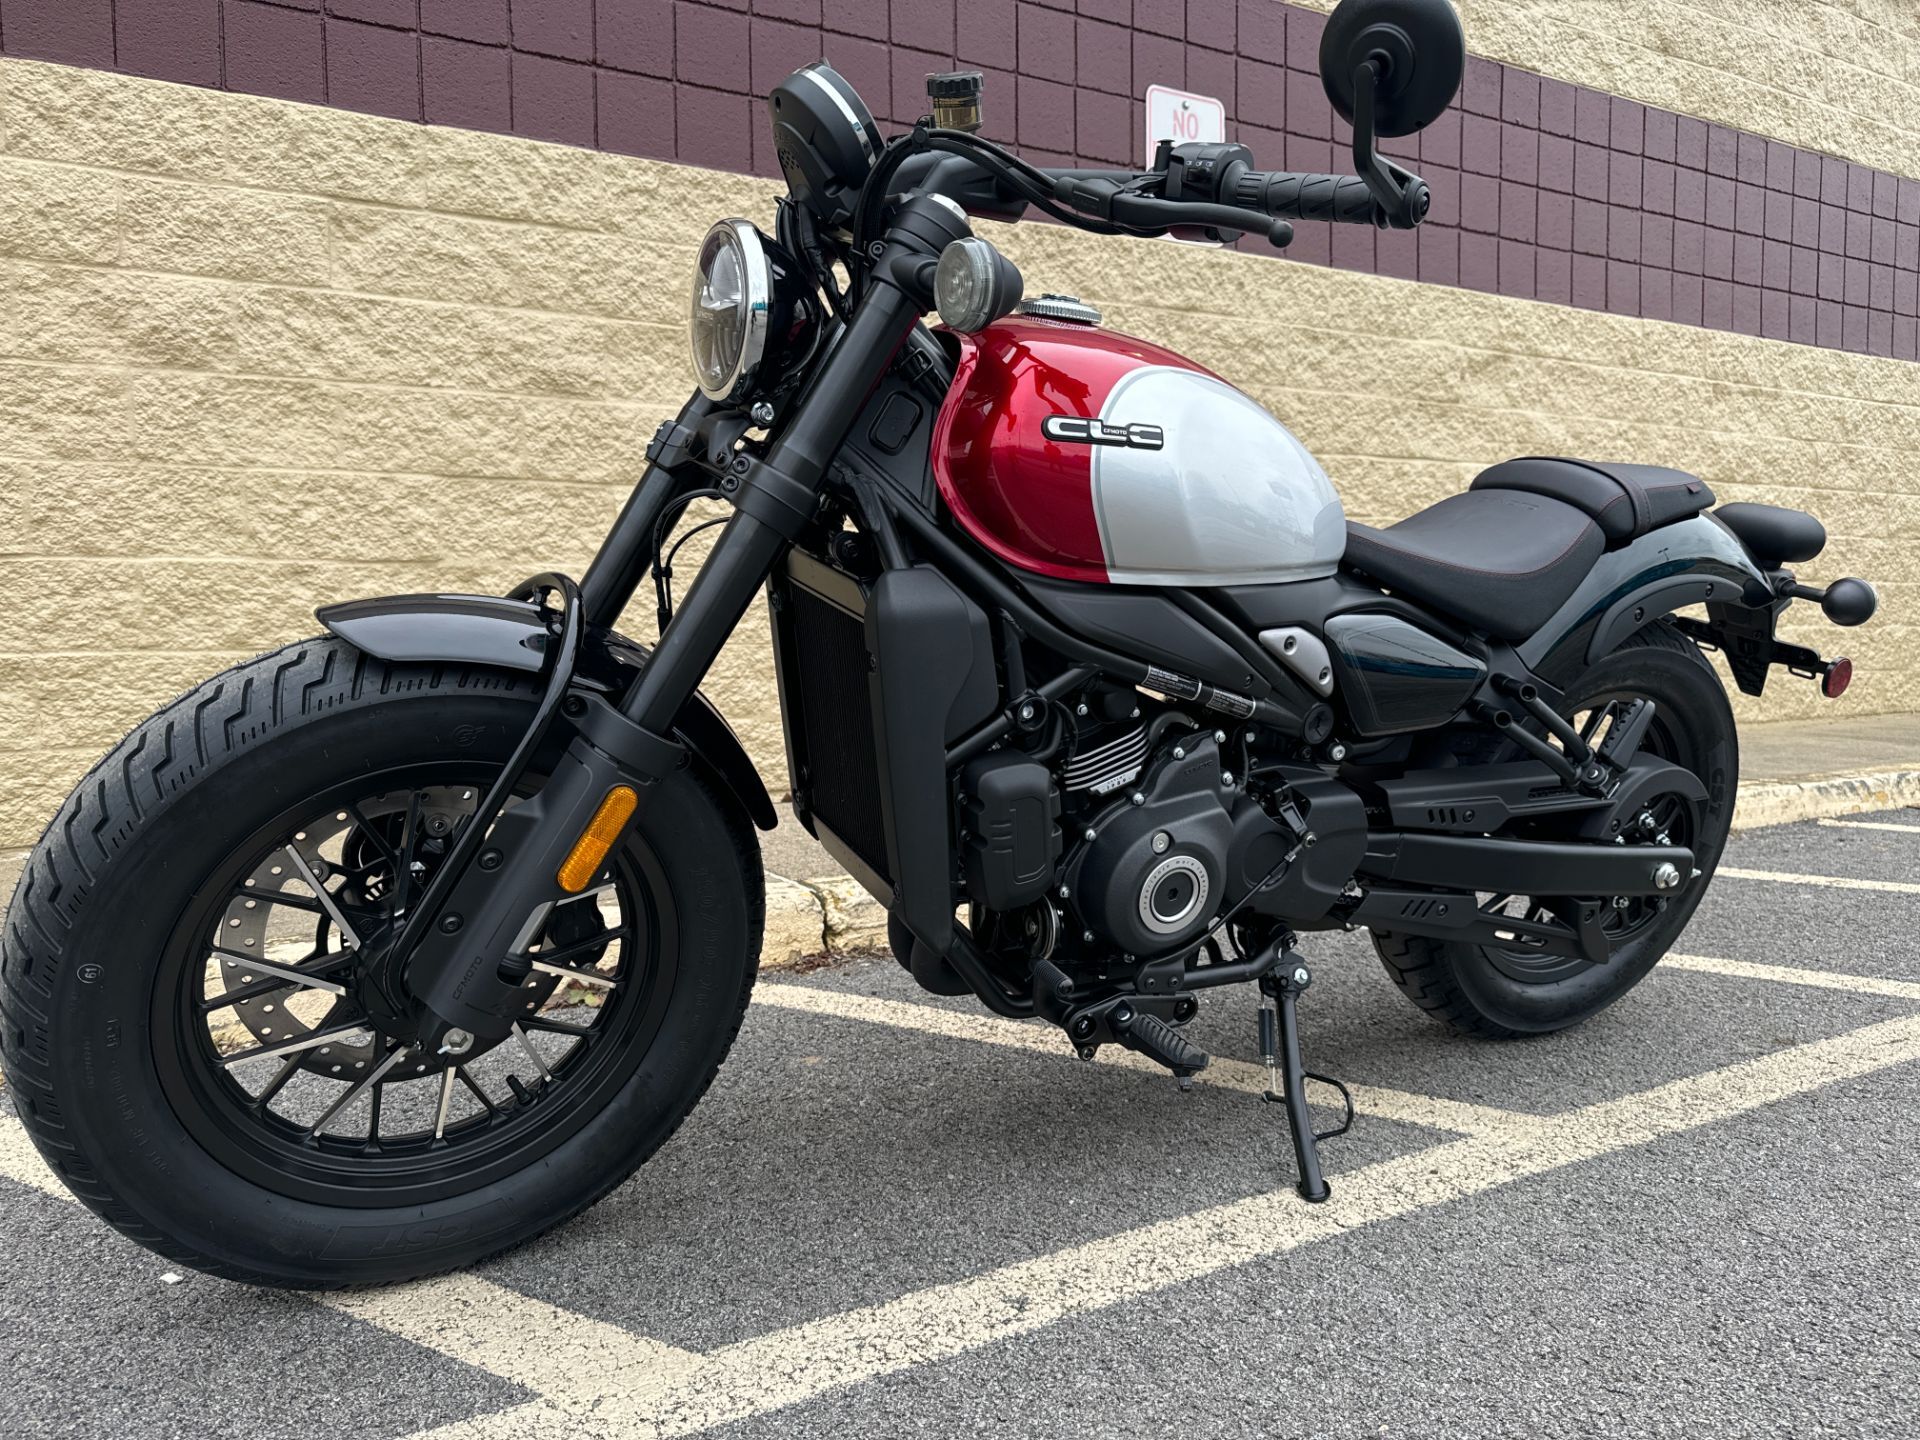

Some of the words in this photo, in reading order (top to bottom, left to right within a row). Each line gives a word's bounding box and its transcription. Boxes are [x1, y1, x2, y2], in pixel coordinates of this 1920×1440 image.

[1172, 109, 1199, 140] NO
[1103, 427, 1128, 436] CFMOTO
[452, 955, 484, 1001] CFMOTO
